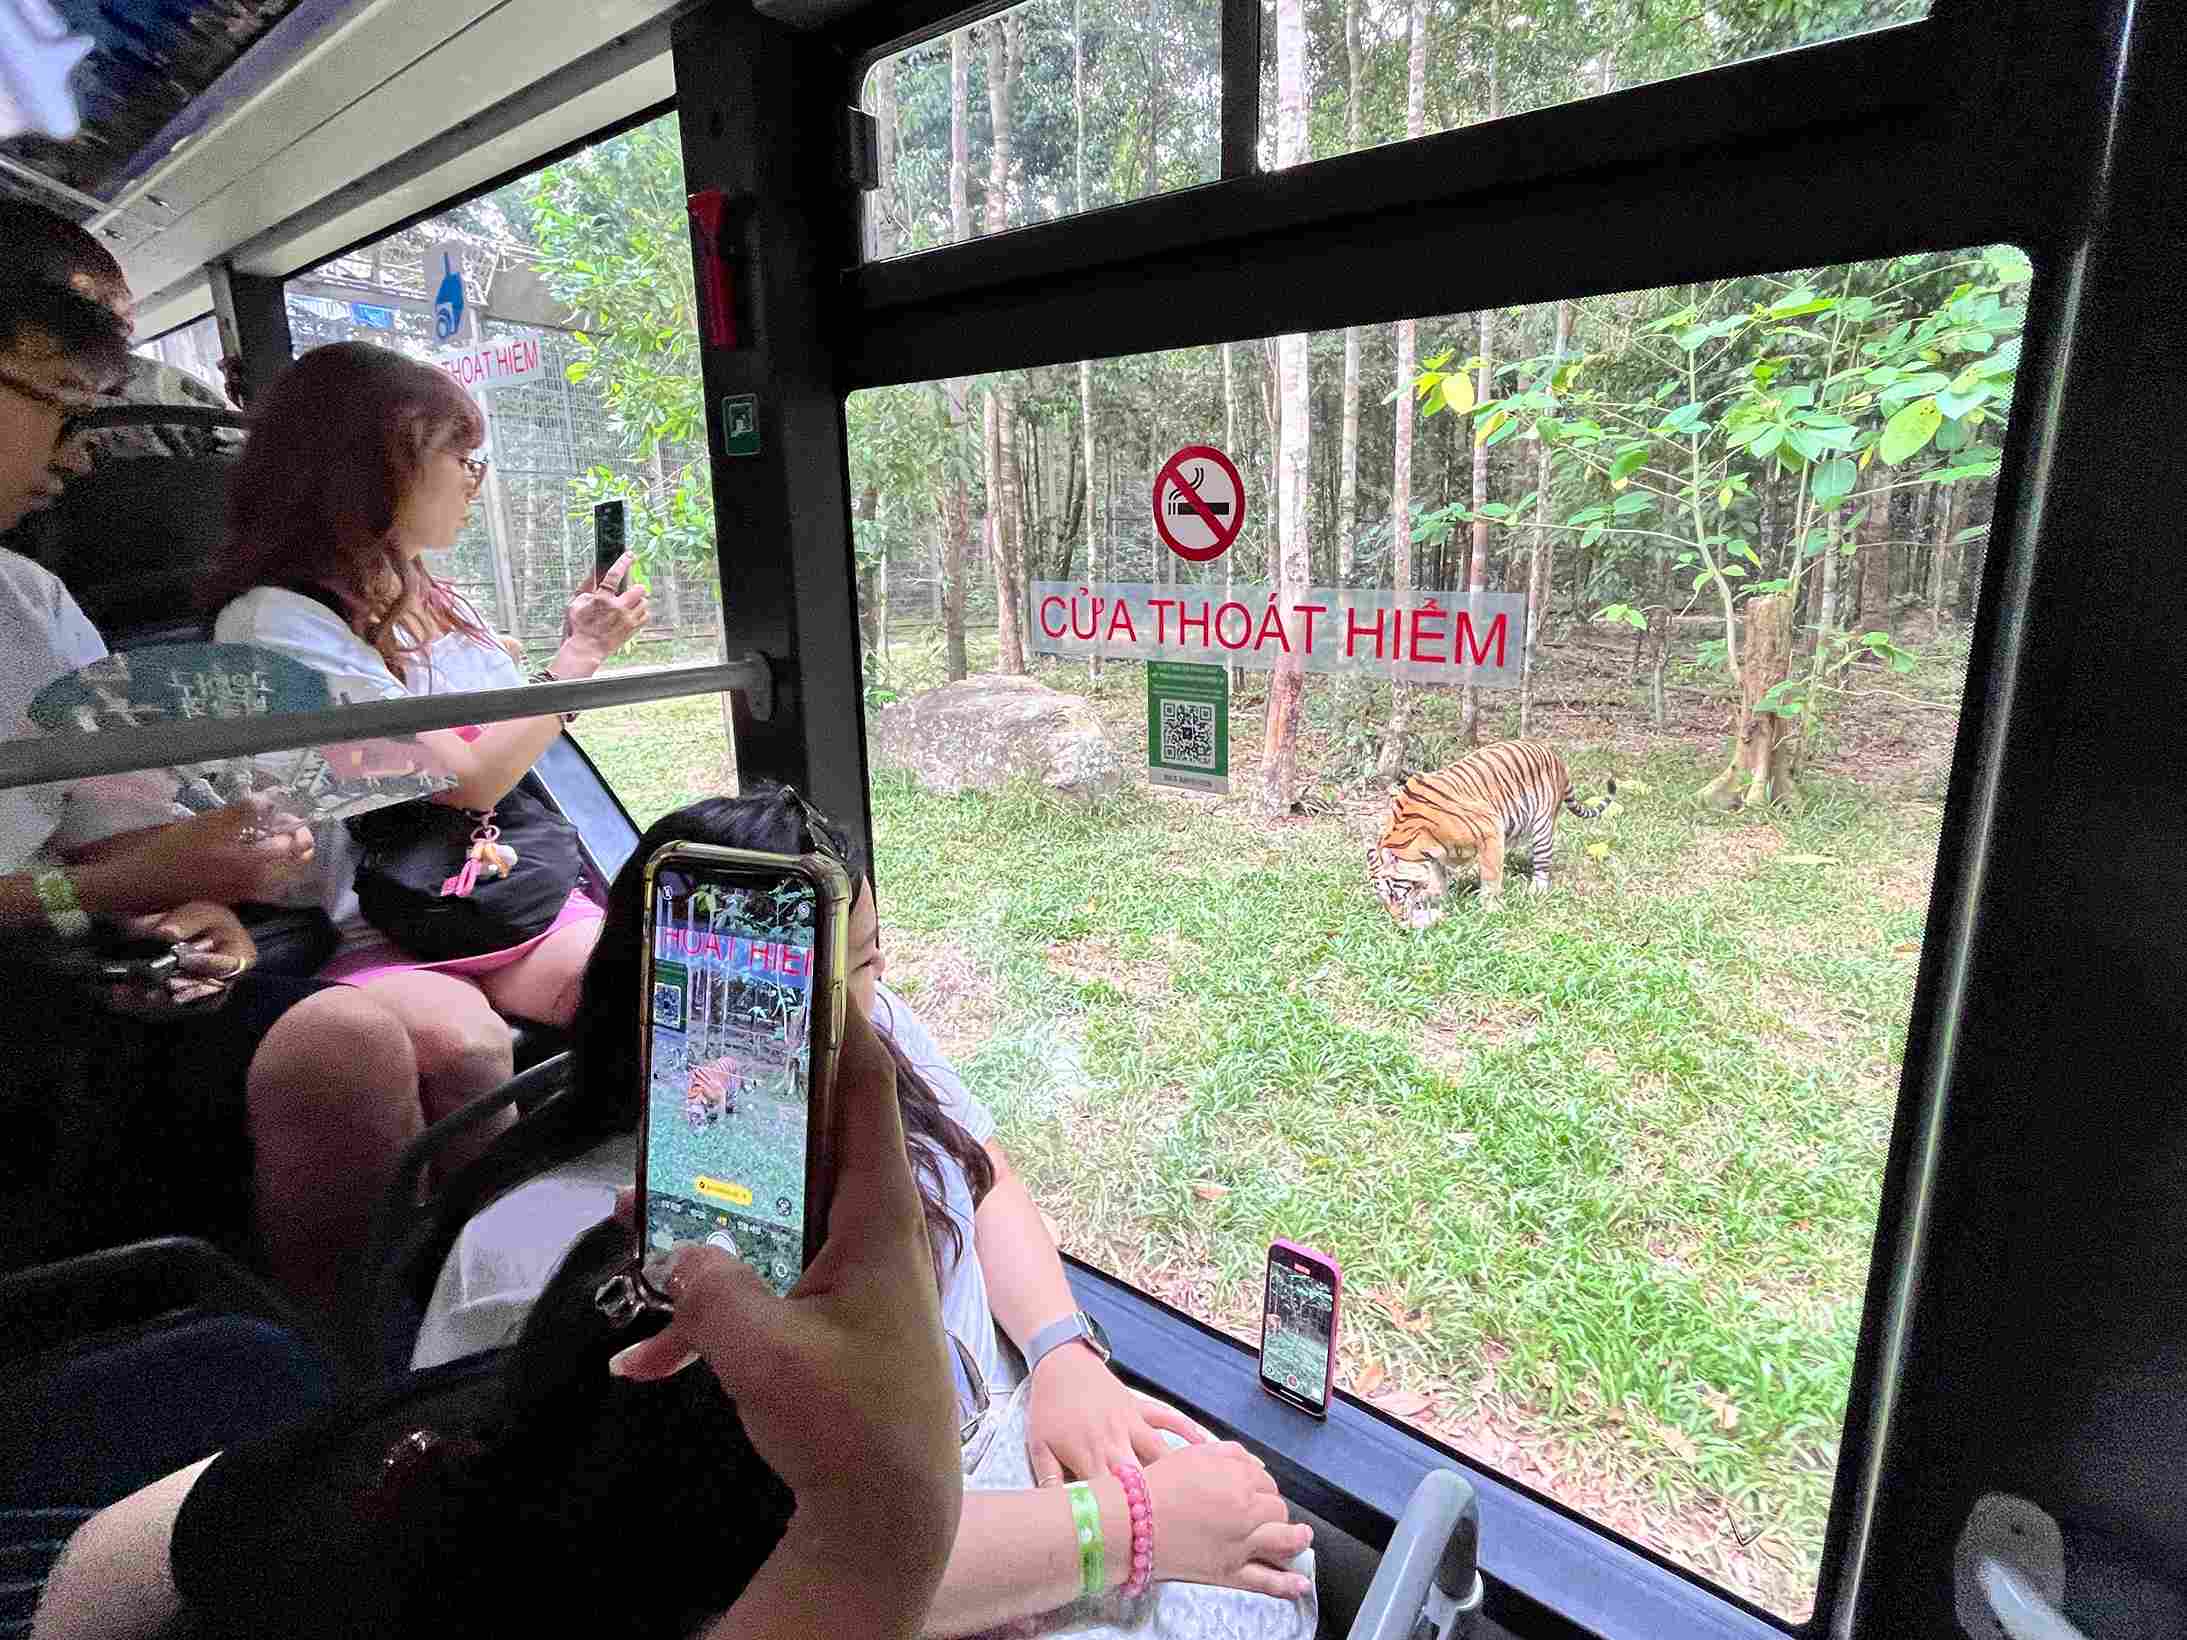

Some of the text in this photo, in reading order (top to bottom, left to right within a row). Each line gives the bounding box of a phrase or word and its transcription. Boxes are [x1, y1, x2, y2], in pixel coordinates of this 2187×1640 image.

[1039, 586, 1508, 668] CỬA THOÁT HIỂM
